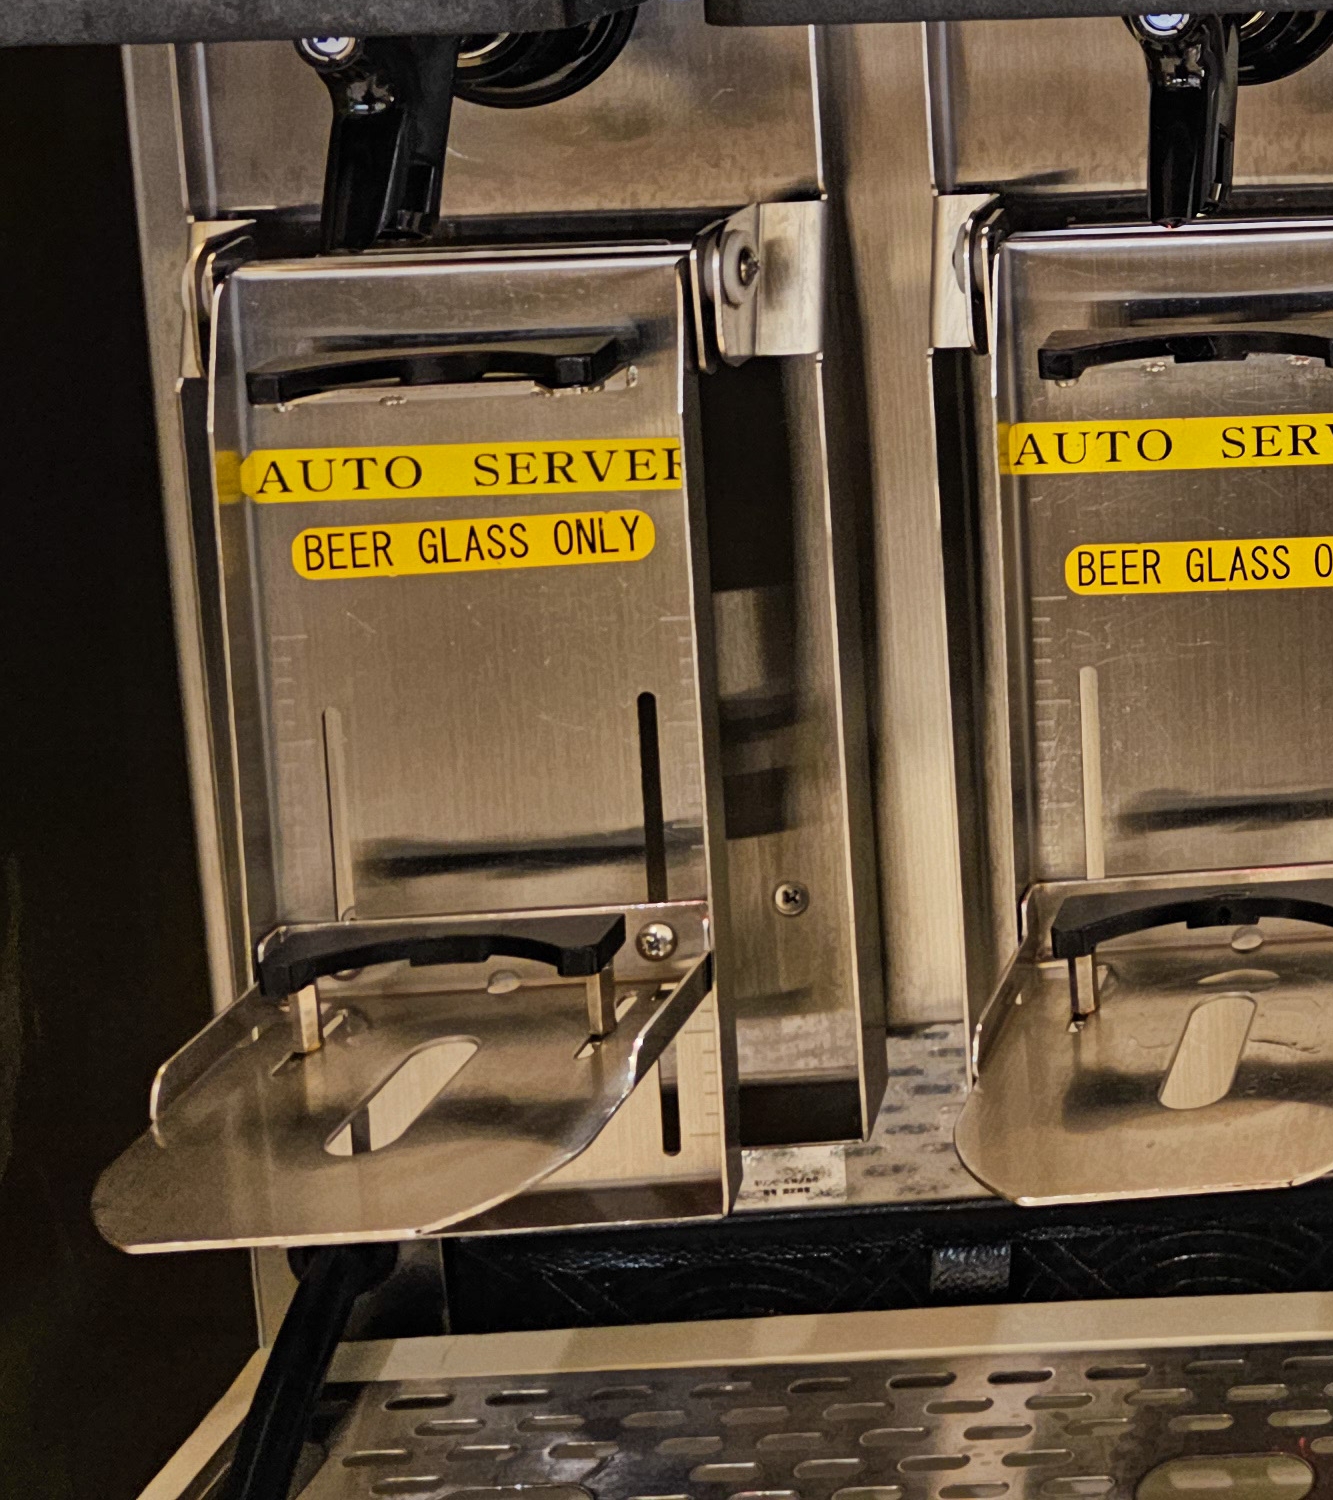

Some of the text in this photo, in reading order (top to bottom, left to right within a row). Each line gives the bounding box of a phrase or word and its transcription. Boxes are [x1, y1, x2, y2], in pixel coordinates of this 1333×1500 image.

[1013, 429, 1173, 466] AUTO
[256, 456, 423, 494] AUTO
[305, 515, 640, 570] BEER GLASS ONLY
[1078, 549, 1161, 587] BEER
[1186, 545, 1290, 583] GLASS
